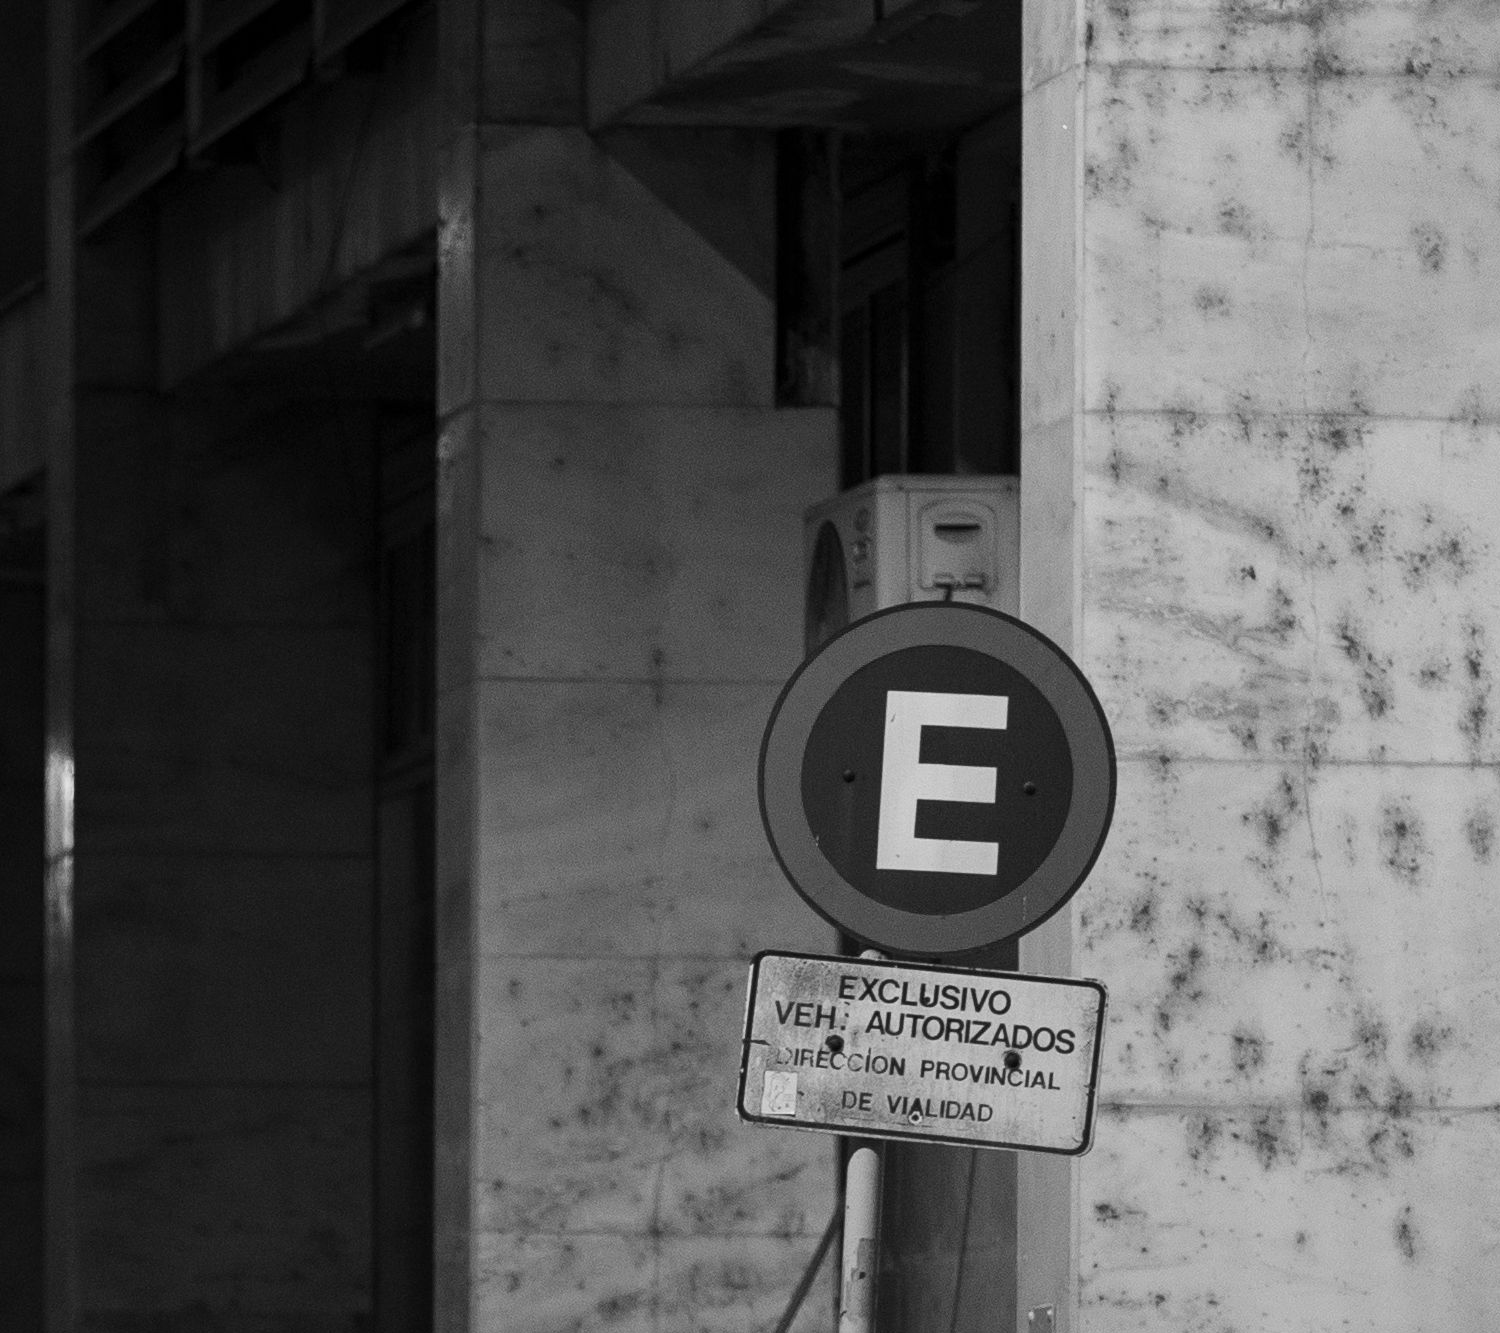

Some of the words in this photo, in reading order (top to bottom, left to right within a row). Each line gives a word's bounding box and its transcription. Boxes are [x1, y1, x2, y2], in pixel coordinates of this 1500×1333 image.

[876, 690, 1009, 875] E
[838, 975, 1012, 1015] EXCLUSIVO
[865, 1011, 1076, 1054] AUTORIZADOS
[920, 1060, 1061, 1090] PROVINCIAL
[842, 1091, 873, 1111] DE
[887, 1095, 993, 1122] VIALIDAD
